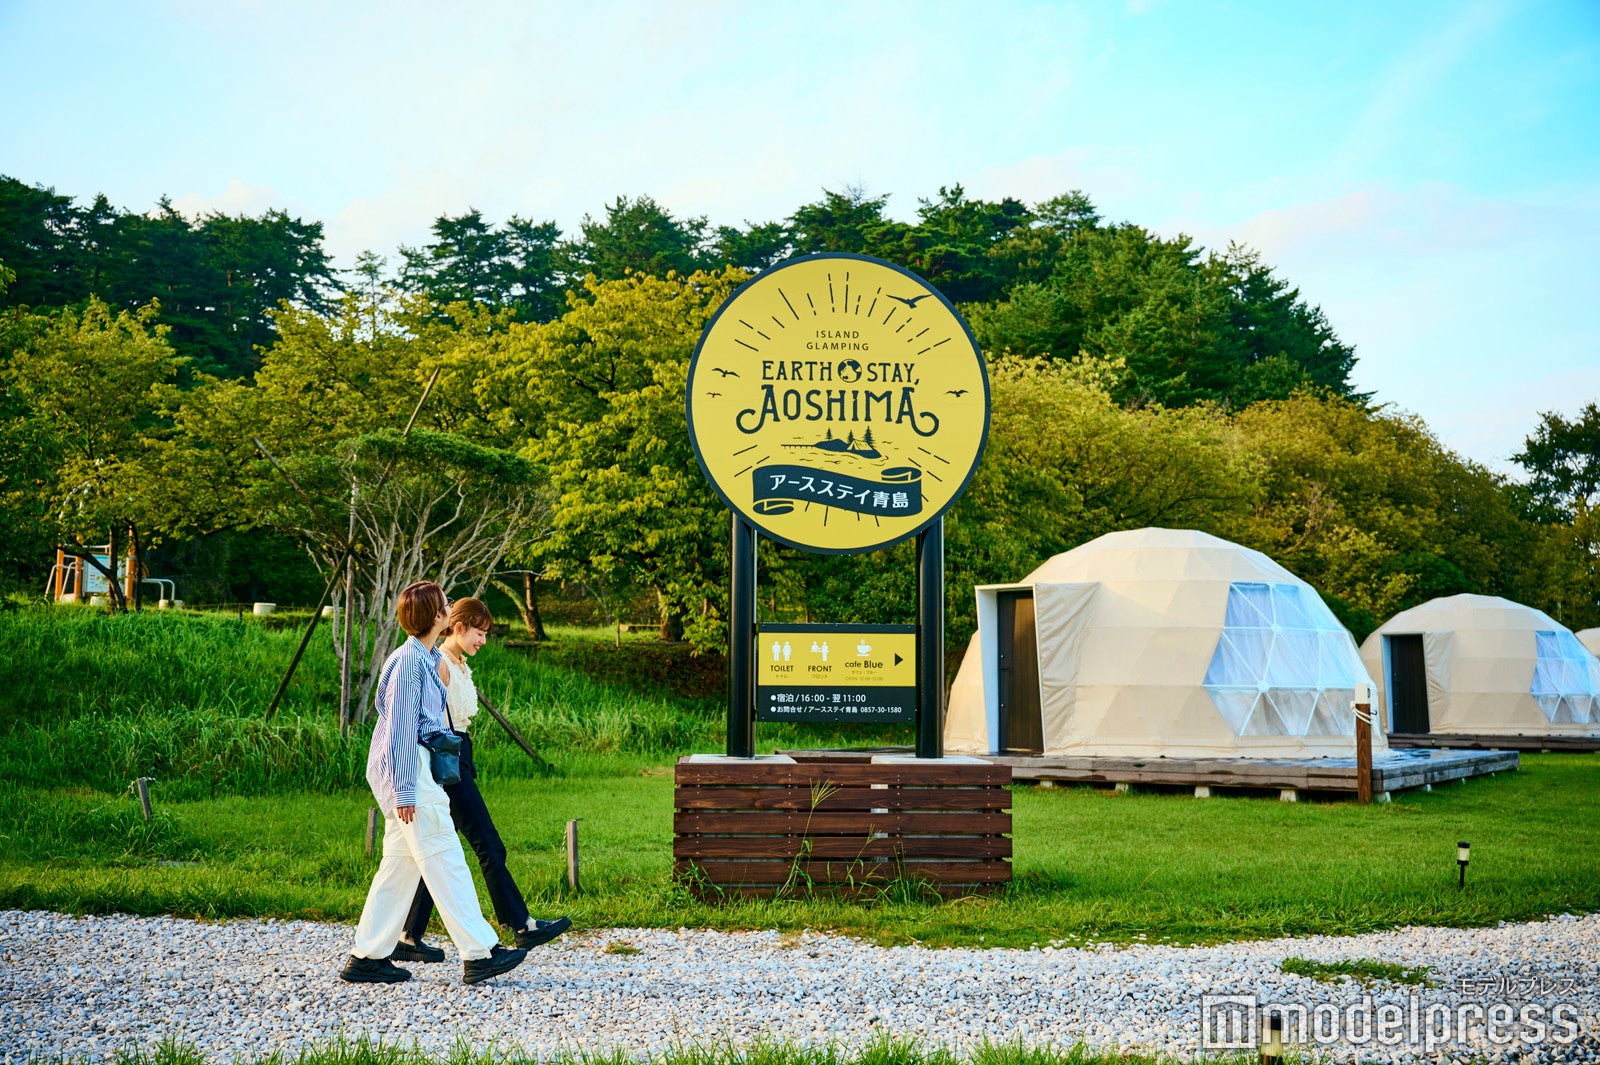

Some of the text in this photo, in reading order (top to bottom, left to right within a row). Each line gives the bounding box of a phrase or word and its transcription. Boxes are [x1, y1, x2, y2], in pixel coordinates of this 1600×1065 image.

[816, 330, 860, 339] ISLAND
[806, 342, 869, 351] GLAMPING
[761, 360, 833, 381] EARTH
[735, 384, 940, 437] AOSHIMA
[769, 474, 909, 509] アースステイ青島
[863, 660, 884, 669] Blue
